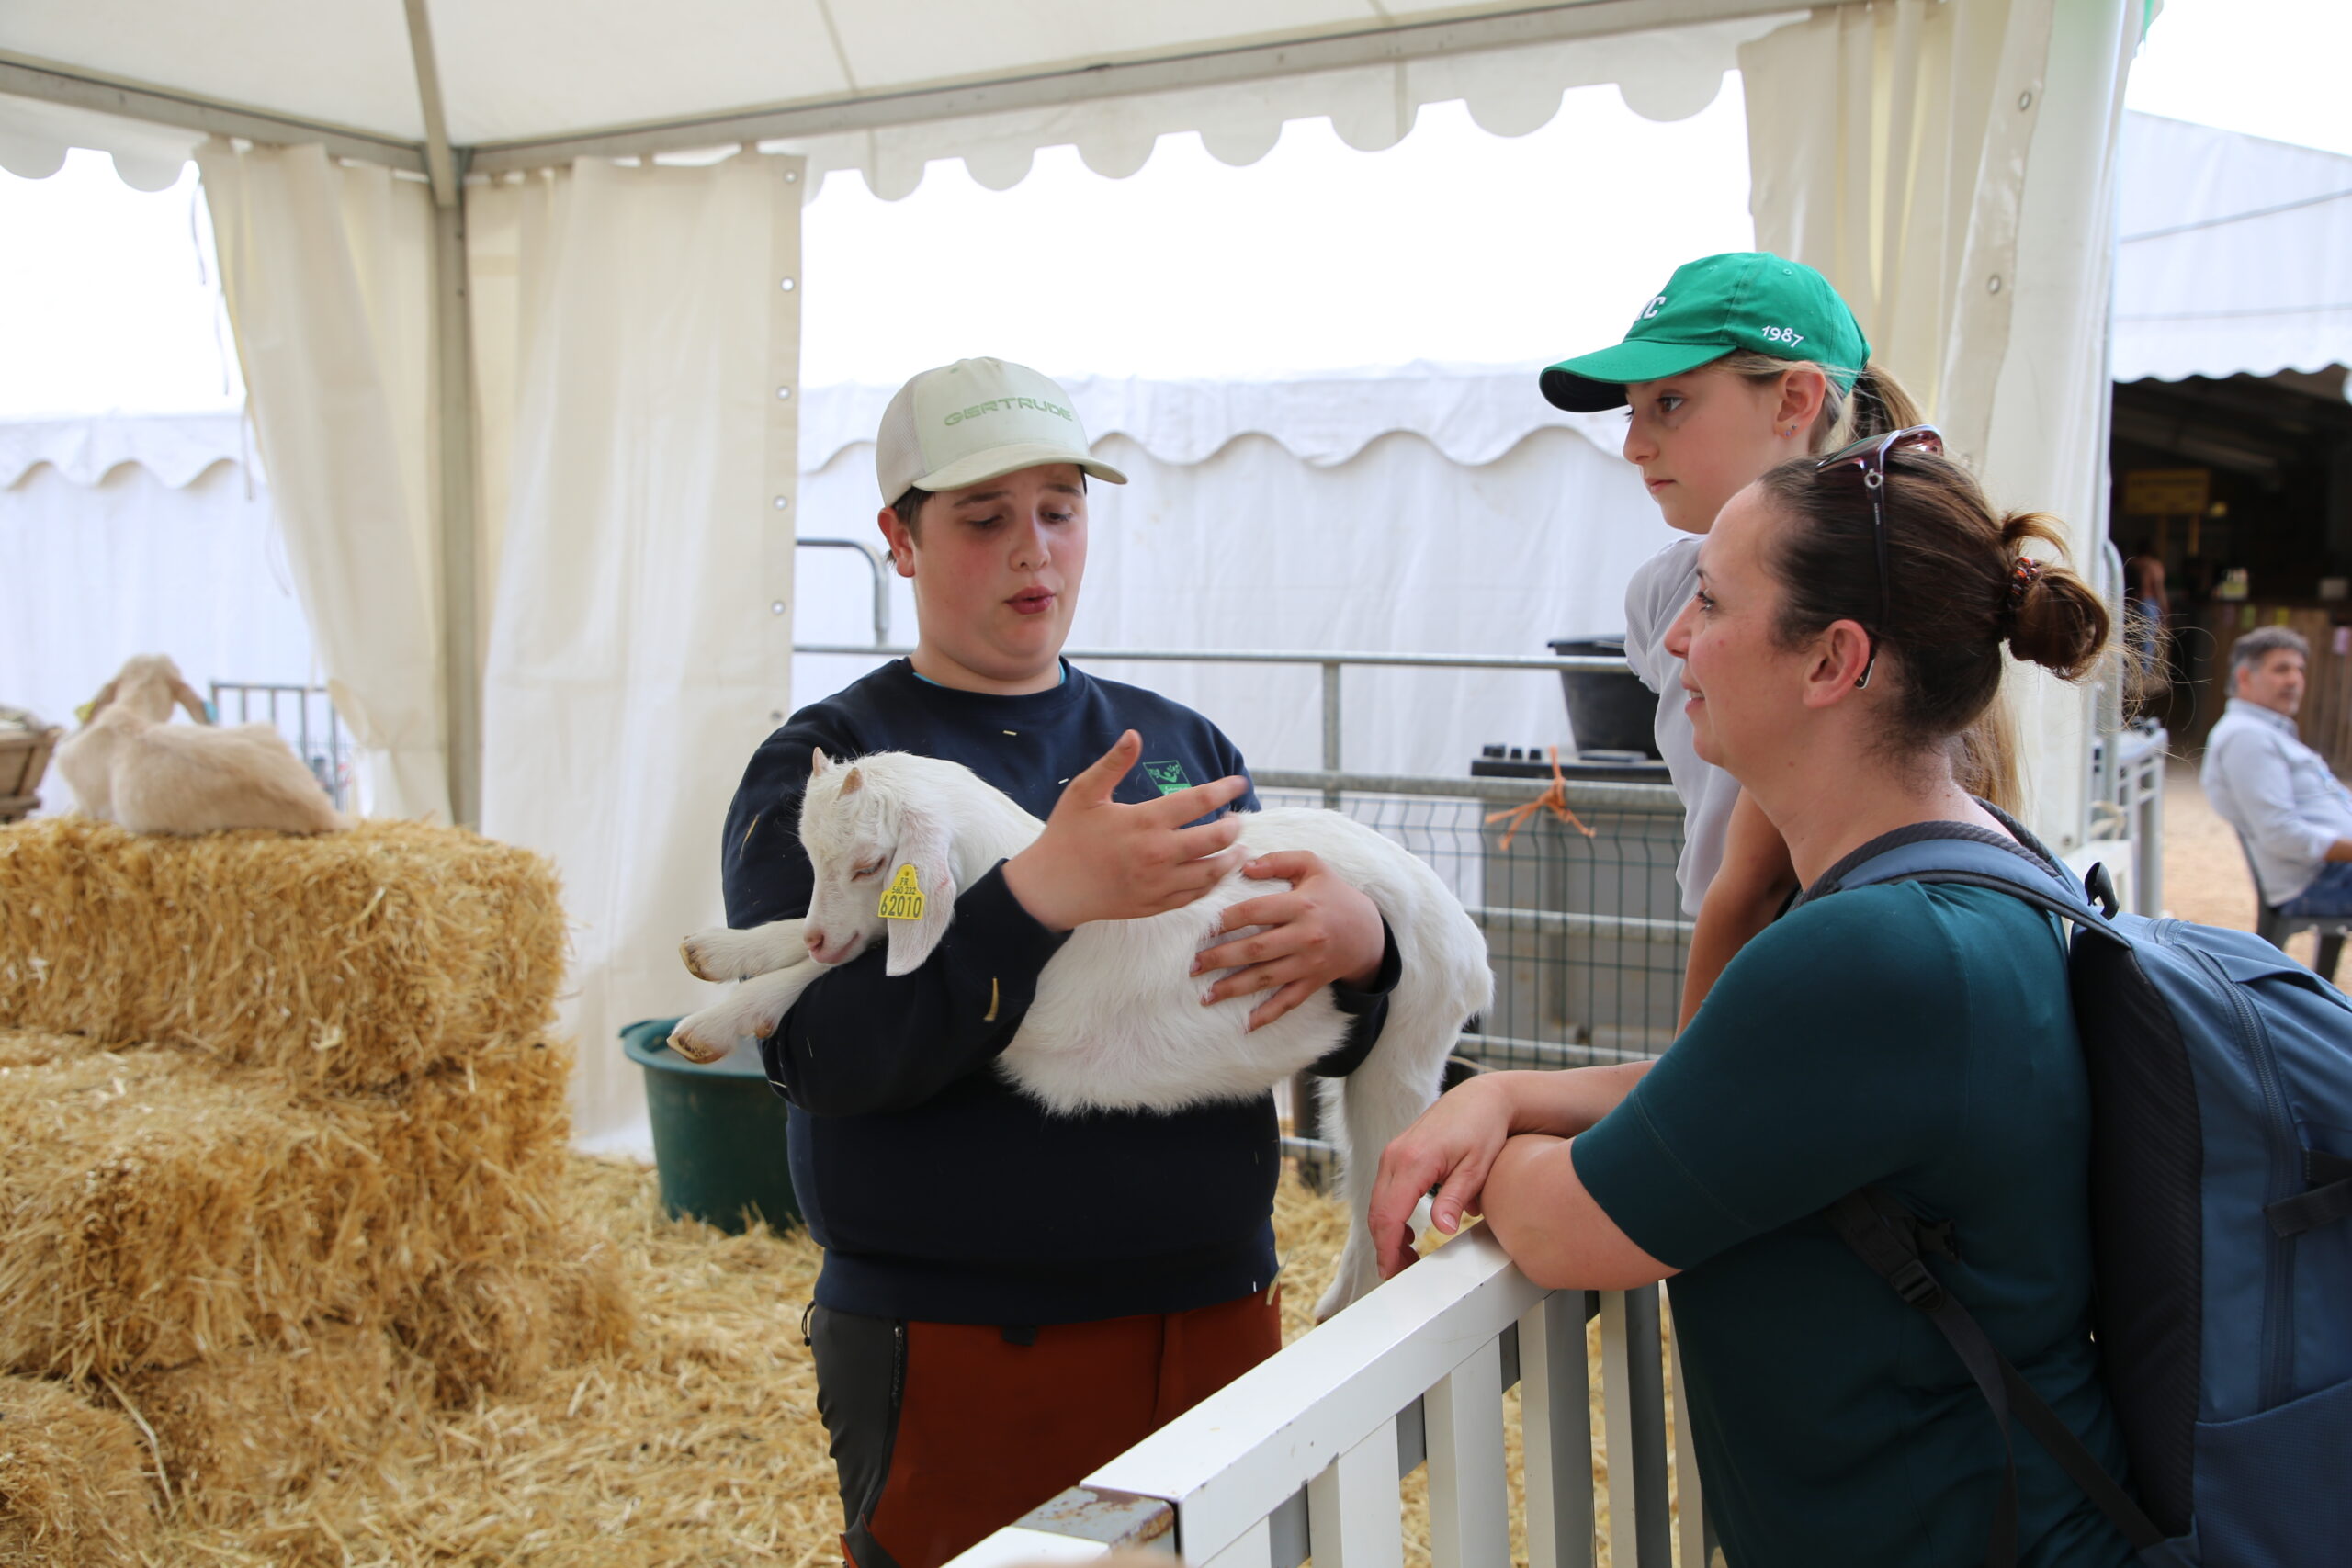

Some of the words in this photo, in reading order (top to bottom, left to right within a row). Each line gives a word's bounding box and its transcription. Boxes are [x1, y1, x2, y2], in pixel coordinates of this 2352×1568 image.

[1761, 325, 1804, 348] 1987
[944, 397, 1073, 426] GERTRUDE
[880, 894, 922, 918] 62010
